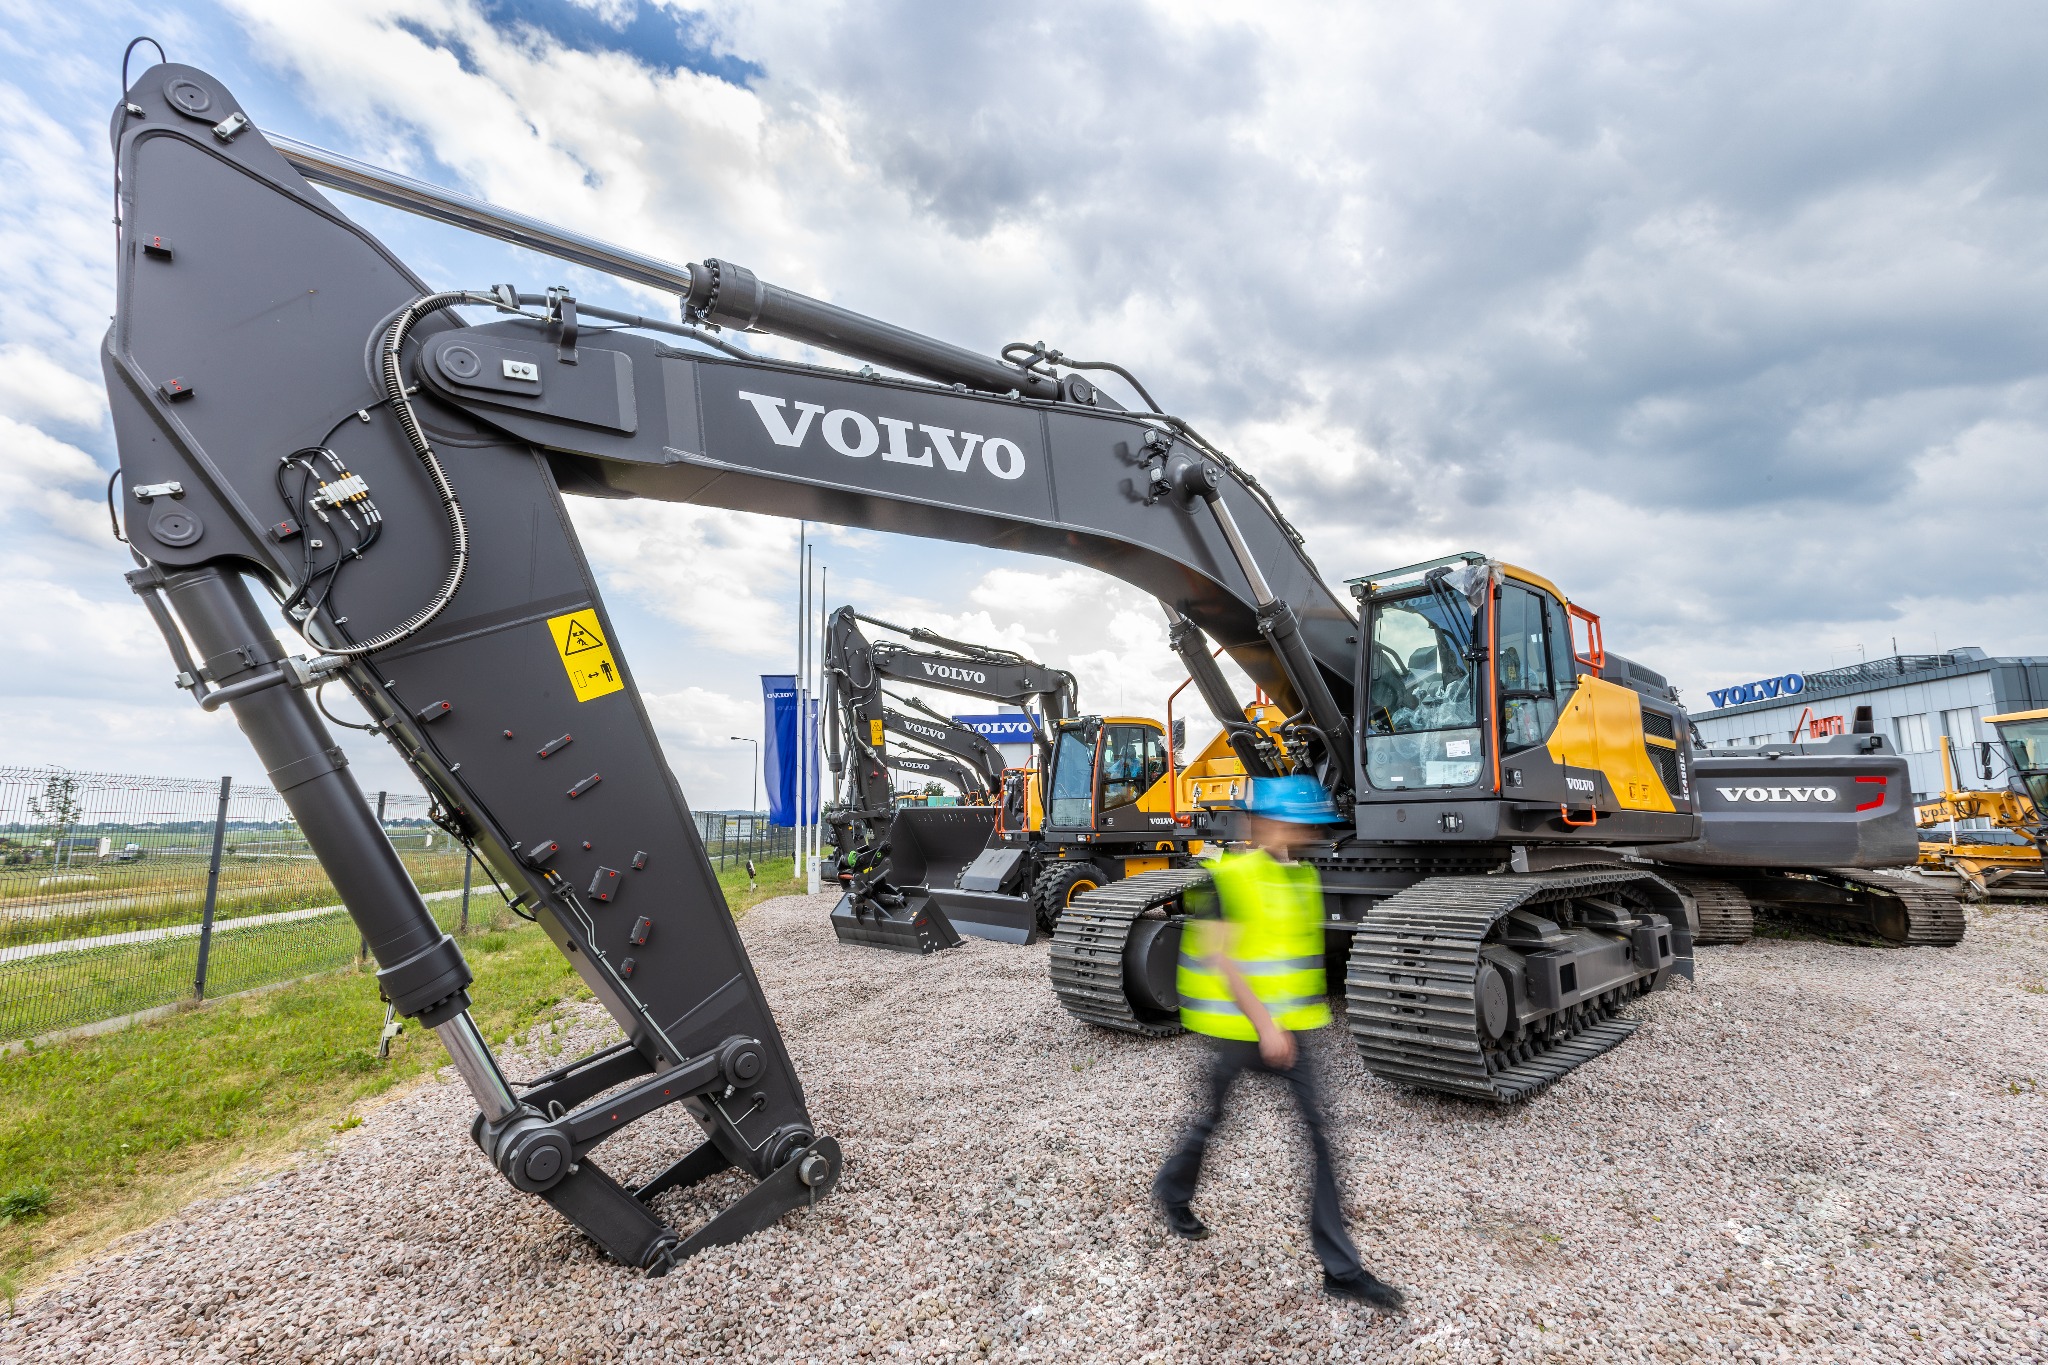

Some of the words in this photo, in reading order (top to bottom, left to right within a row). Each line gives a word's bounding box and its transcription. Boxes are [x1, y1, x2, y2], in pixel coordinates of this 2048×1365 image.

[738, 390, 1026, 480] VOLVO
[922, 661, 986, 684] VOLVO
[1706, 673, 1805, 708] VOLVO
[904, 720, 946, 740] VOLVO
[962, 722, 1033, 735] VOLVO
[899, 760, 931, 770] VOLVO
[1565, 777, 1595, 792] VOLVO
[1716, 787, 1837, 802] VOLVO
[1149, 817, 1175, 825] VOLVO
